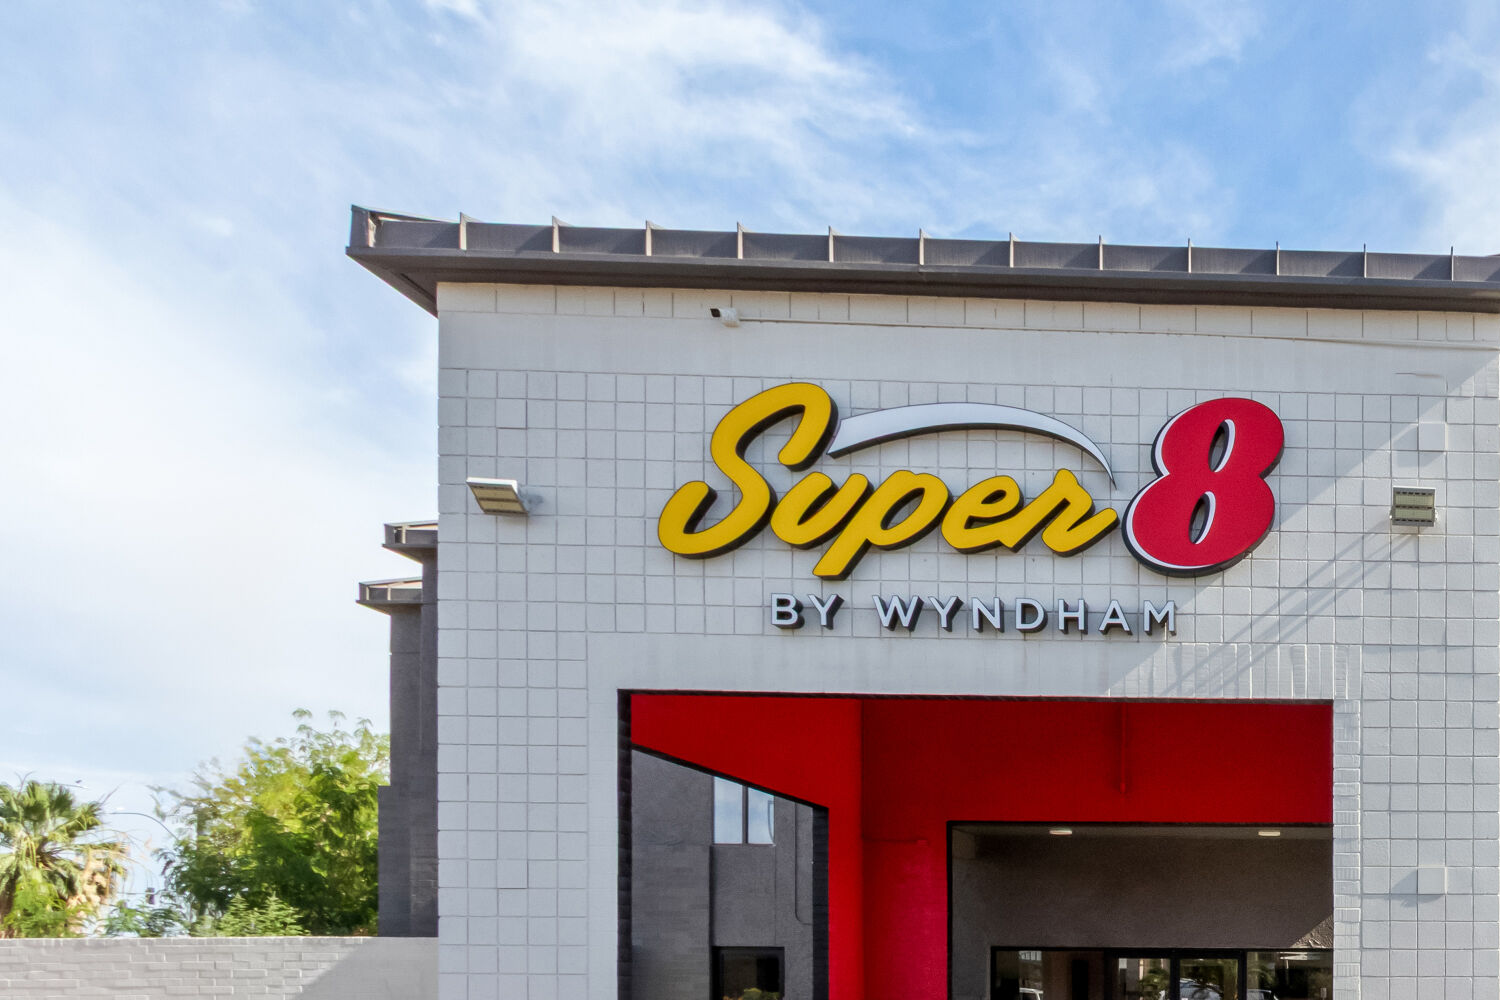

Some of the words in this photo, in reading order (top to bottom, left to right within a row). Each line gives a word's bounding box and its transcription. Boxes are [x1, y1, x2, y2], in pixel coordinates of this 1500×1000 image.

[658, 382, 1120, 580] Super
[1121, 397, 1285, 578] 8
[771, 593, 845, 630] BY
[872, 595, 1178, 635] WYNDHAM
